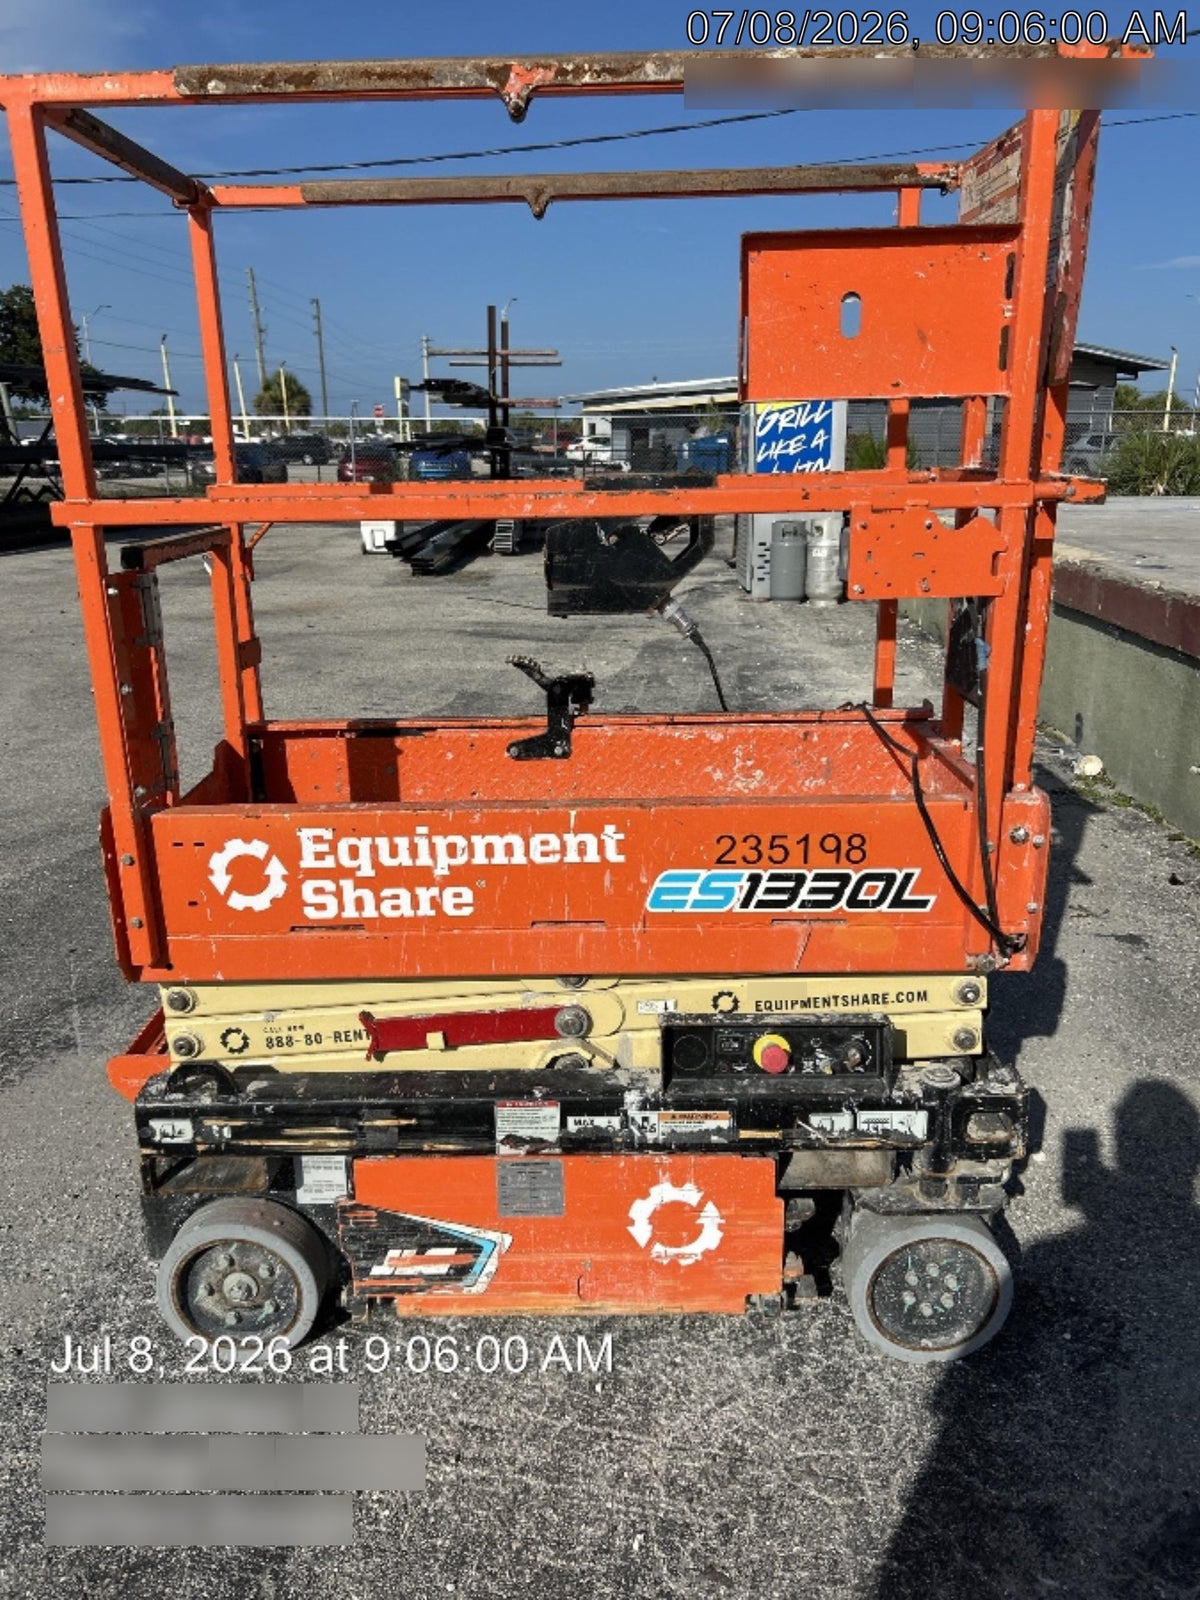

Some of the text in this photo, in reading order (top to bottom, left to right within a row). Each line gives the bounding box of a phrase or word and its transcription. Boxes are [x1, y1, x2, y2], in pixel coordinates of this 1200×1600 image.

[756, 401, 833, 437] GRILL
[756, 429, 831, 462] LIKE A
[297, 824, 625, 876] Equipment
[715, 833, 867, 865] 235198
[302, 879, 475, 920] Share
[646, 868, 937, 912] ES1330L
[754, 990, 929, 1013] EQUIPMENTSHARE.COM
